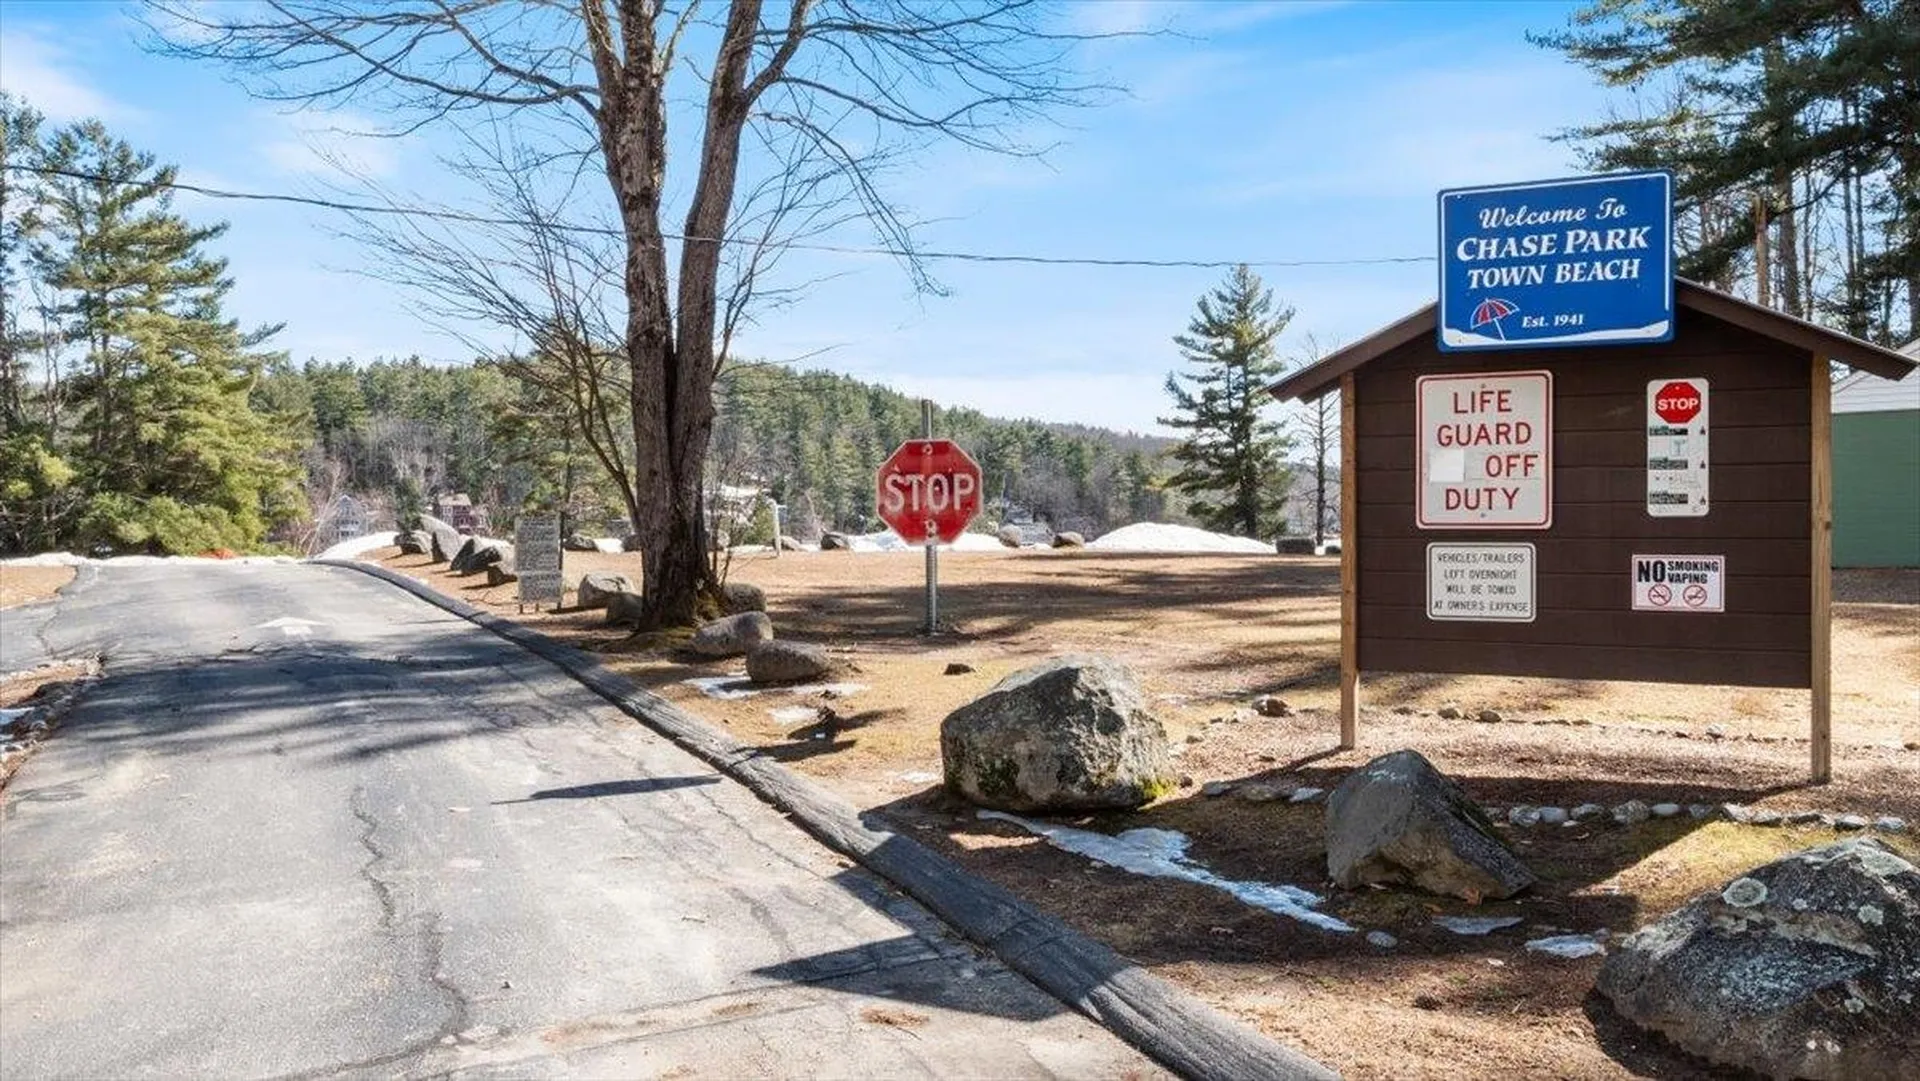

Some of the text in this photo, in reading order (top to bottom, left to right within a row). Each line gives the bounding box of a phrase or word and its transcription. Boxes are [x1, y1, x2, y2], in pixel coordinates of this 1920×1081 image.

[1479, 198, 1627, 228] Welcome To
[1457, 226, 1651, 261] CHASE PARK
[1467, 259, 1641, 289] TOWN BEACH
[1521, 314, 1584, 328] Est. 1941
[1453, 390, 1512, 414] LIFE
[1657, 398, 1699, 411] STOP
[1437, 422, 1532, 447] GUARD
[1485, 454, 1539, 478] OFF
[884, 473, 975, 513] STOP
[1445, 487, 1519, 511] DUTY
[1444, 569, 1516, 579] LEFT OVERNIGHT
[1638, 560, 1719, 583] NO SMOKING
[1667, 573, 1708, 584] VAPING
[1446, 584, 1516, 595] WILL BE TOWED
[1433, 600, 1529, 612] AT OWNERS EXPENSE
